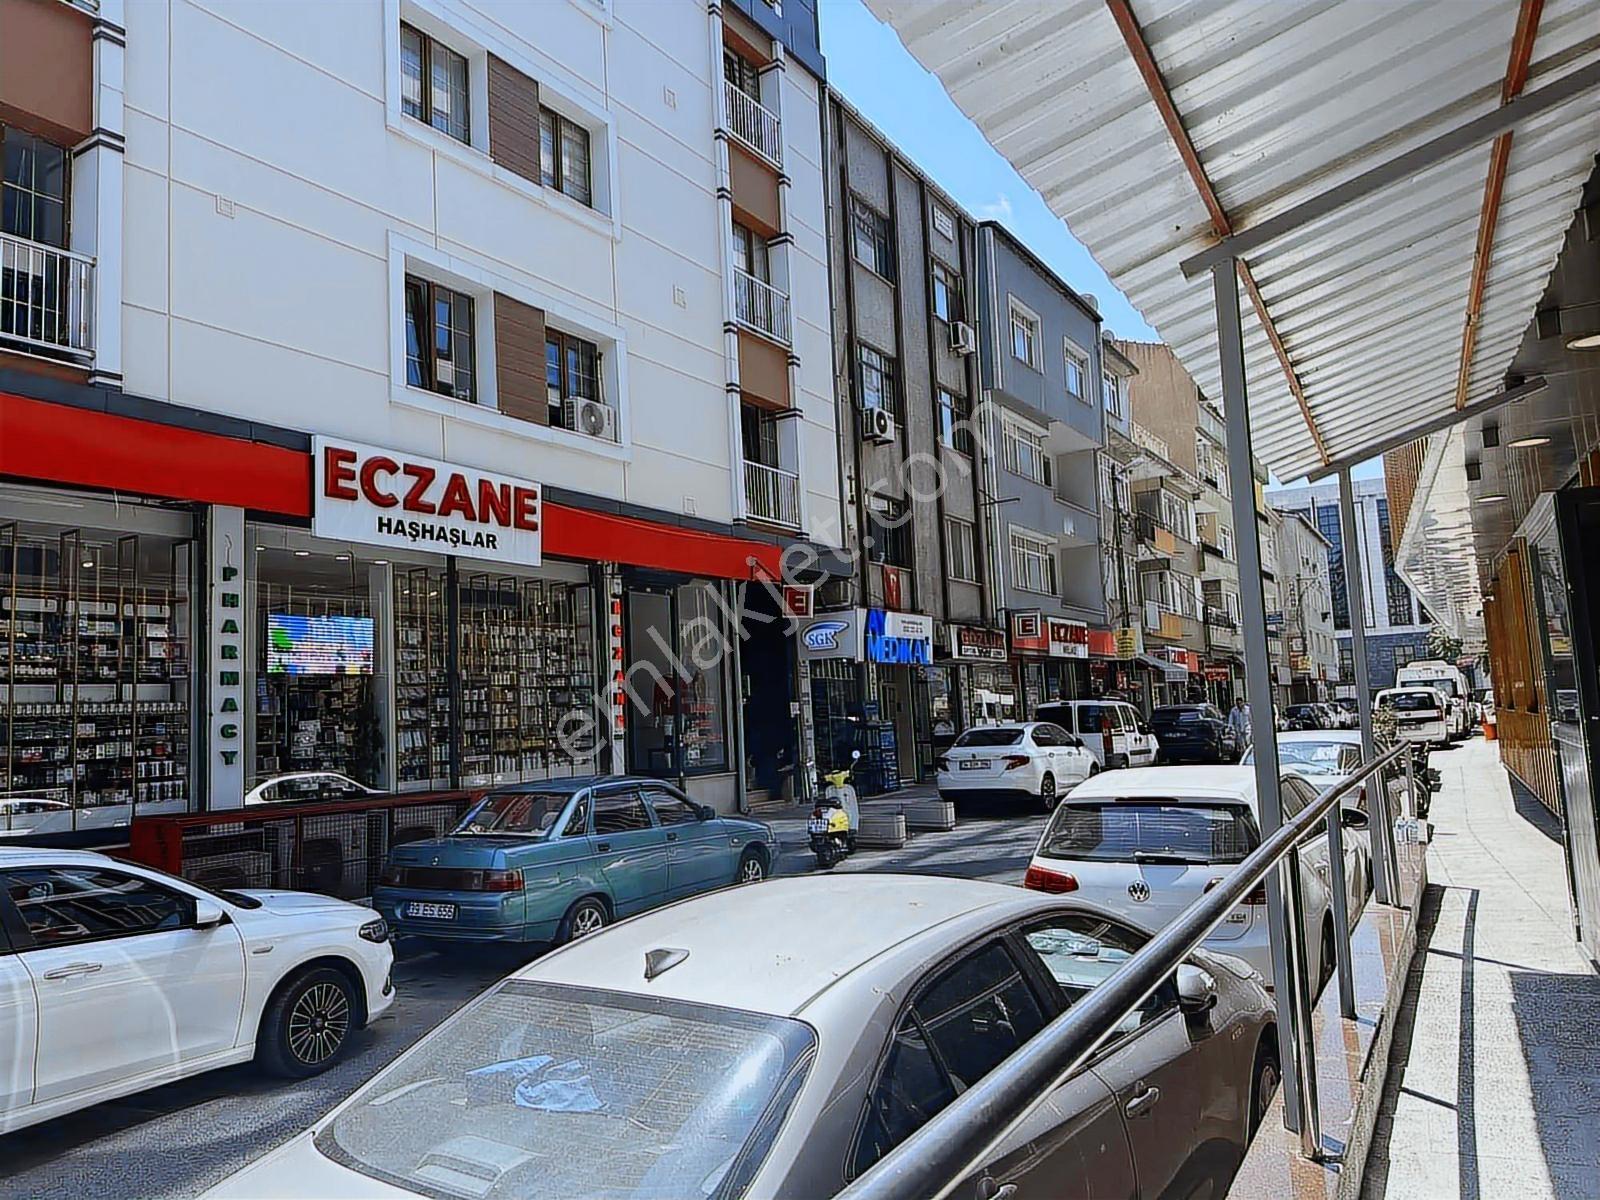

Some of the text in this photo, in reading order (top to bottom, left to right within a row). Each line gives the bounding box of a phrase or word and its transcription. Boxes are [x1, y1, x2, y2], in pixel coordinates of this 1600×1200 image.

[323, 445, 539, 531] ECZANE
[377, 516, 498, 550] HAŞHAŞLAR
[788, 591, 805, 612] E
[808, 632, 835, 646] SGK
[1021, 618, 1034, 634] E
[219, 566, 242, 767] PHARMACY
